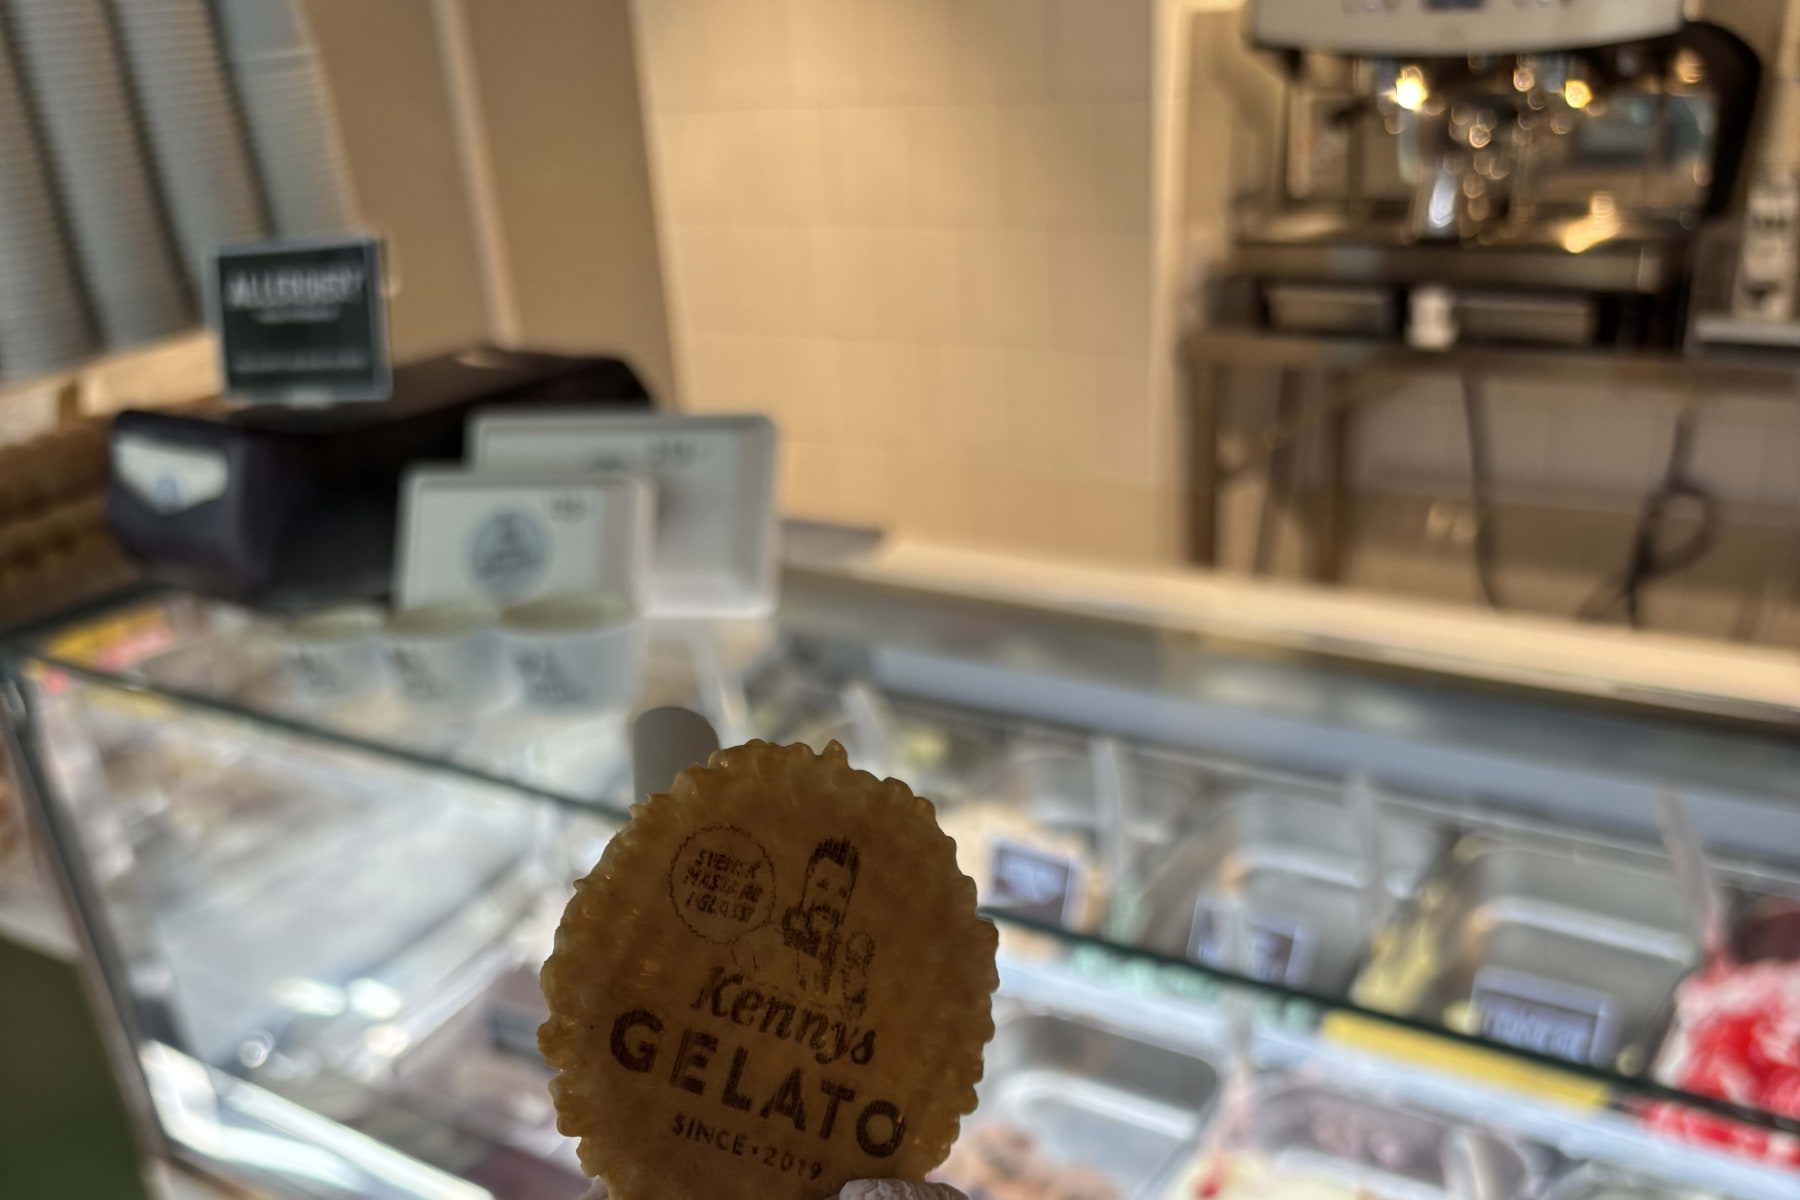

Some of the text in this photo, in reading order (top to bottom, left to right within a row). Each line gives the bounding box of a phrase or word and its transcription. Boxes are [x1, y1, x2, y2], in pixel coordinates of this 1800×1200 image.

[690, 965, 878, 1066] Kennys
[609, 1007, 907, 1158] GELATO
[671, 1112, 824, 1182] SINCE 2019
